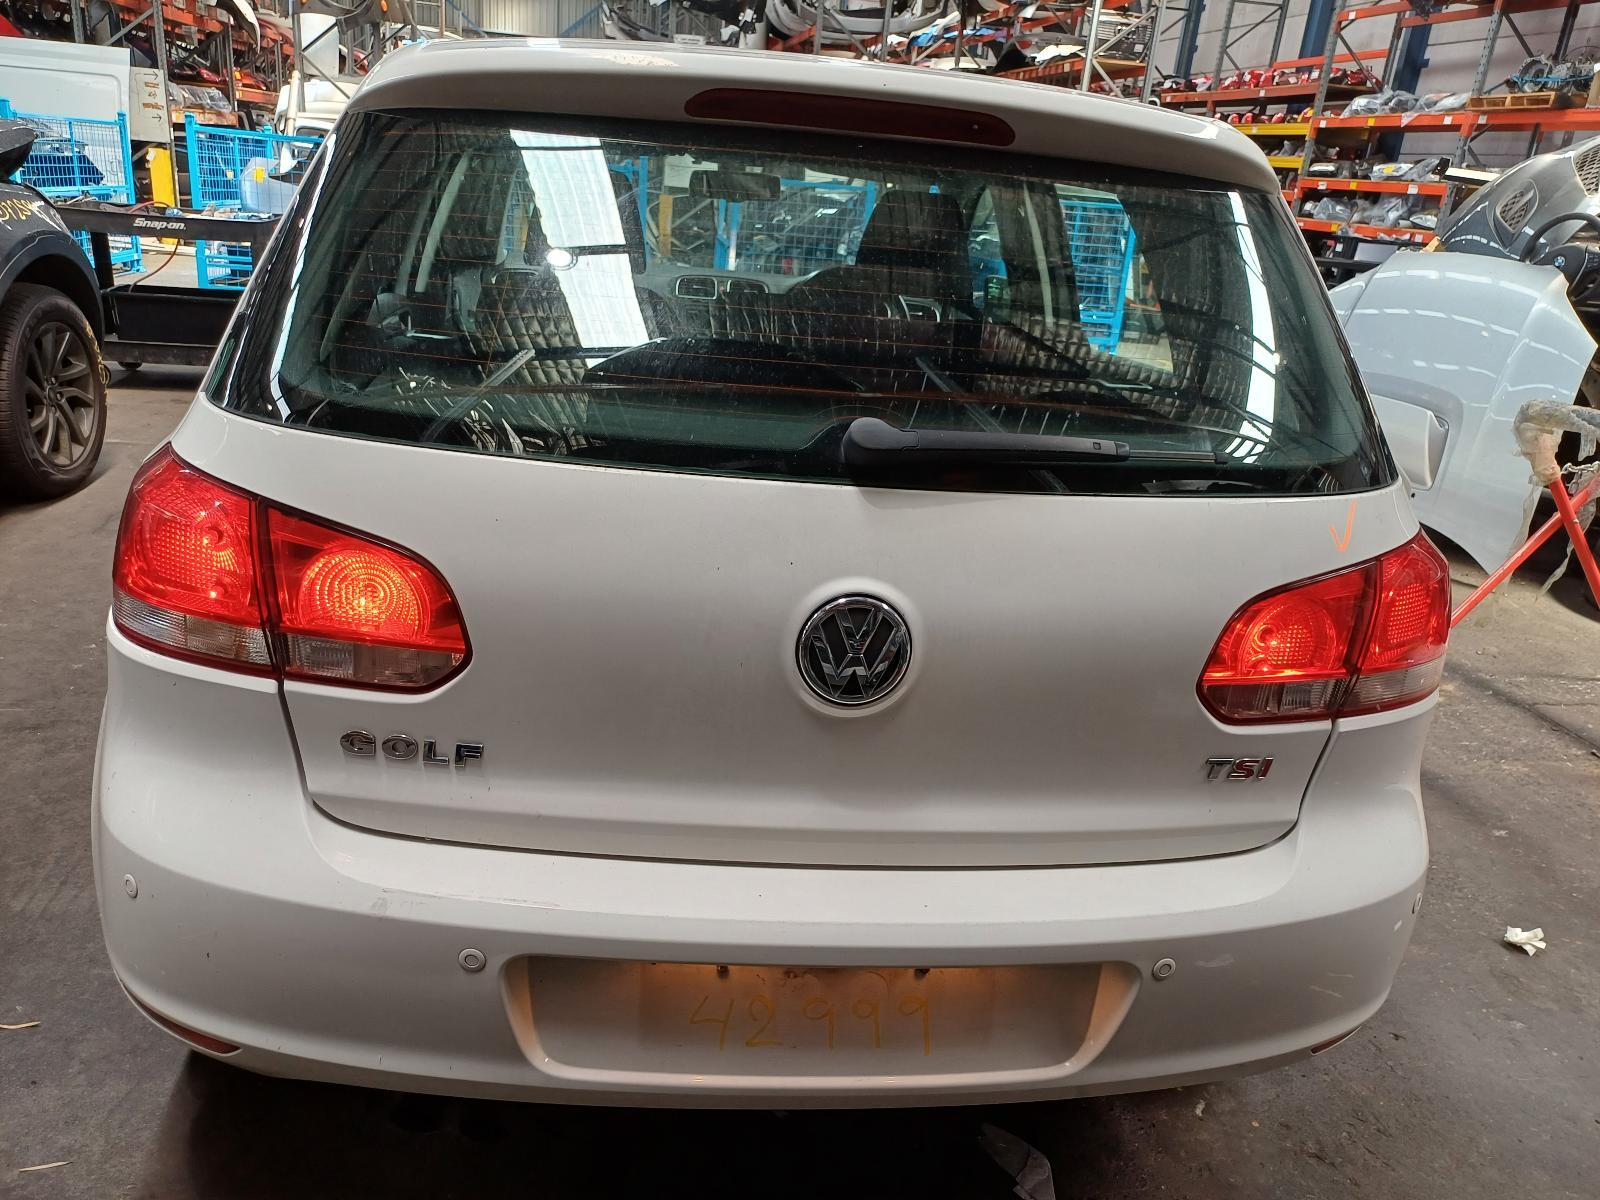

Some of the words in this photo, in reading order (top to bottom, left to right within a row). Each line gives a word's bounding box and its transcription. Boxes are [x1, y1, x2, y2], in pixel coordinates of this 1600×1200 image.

[339, 729, 484, 767] GOLF
[1205, 757, 1275, 781] TSI
[688, 994, 932, 1057] 42999
